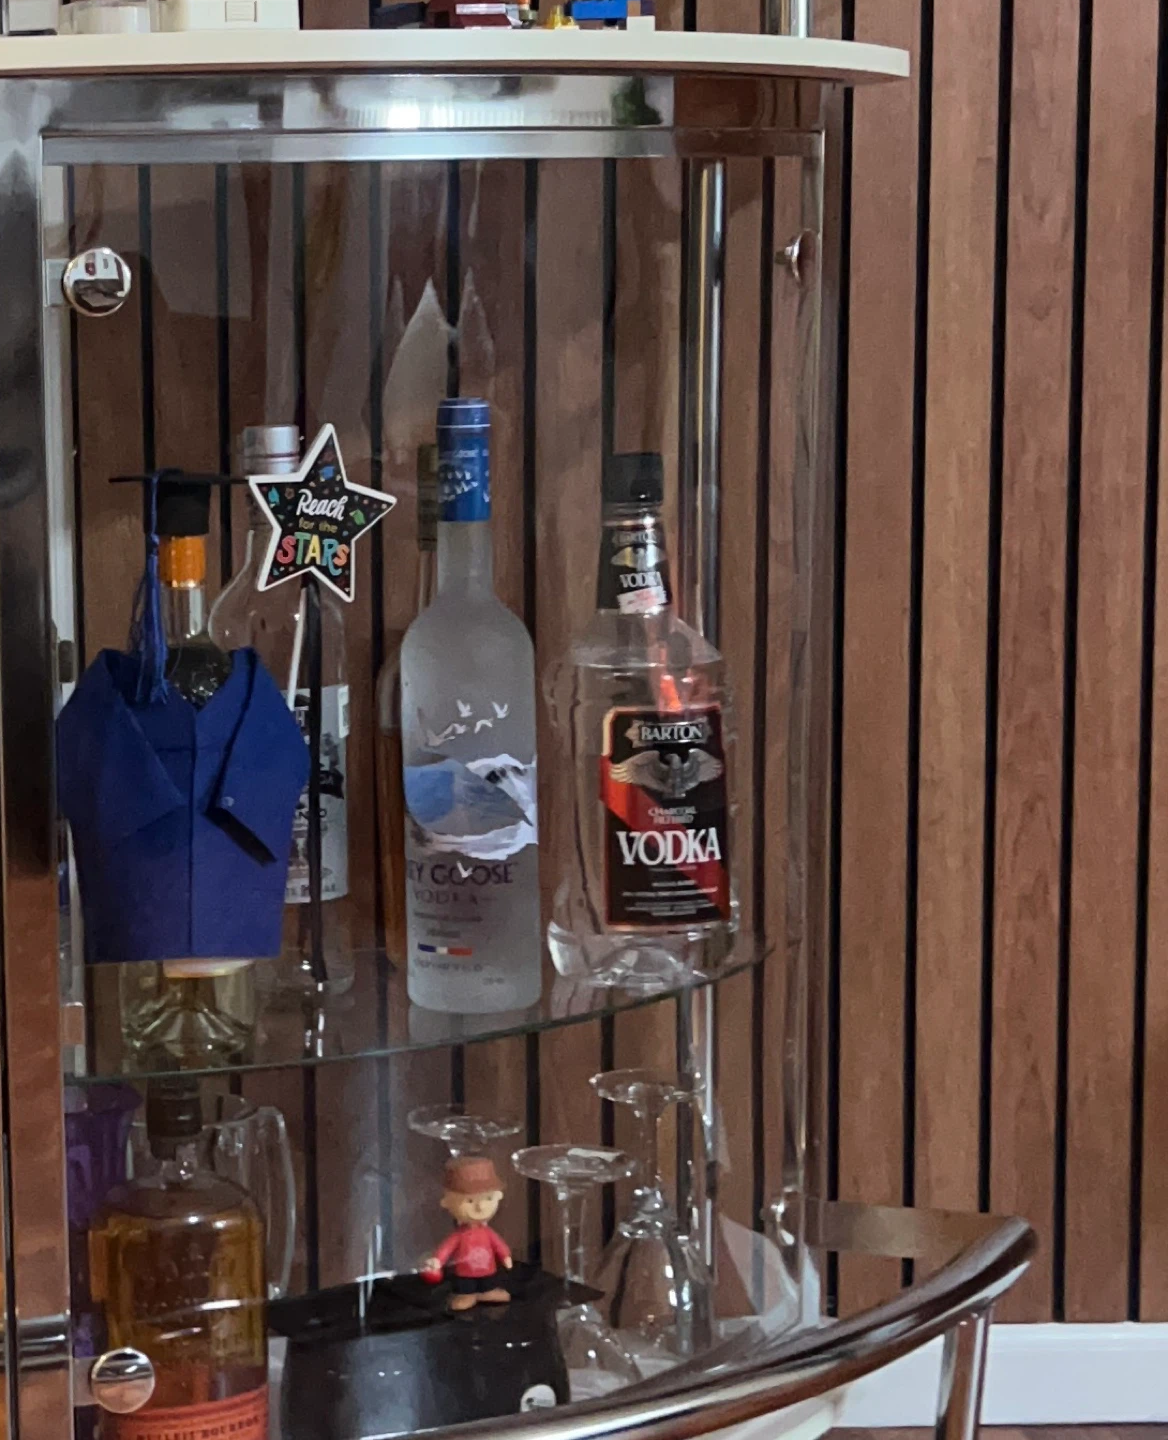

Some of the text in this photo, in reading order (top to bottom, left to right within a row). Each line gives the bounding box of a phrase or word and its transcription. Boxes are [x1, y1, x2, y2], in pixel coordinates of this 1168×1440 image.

[296, 488, 349, 521] Reach
[298, 516, 338, 534] for the
[276, 531, 350, 576] STARS
[640, 723, 703, 742] BARTON
[615, 826, 722, 866] VODKA
[430, 862, 516, 886] GOOSE
